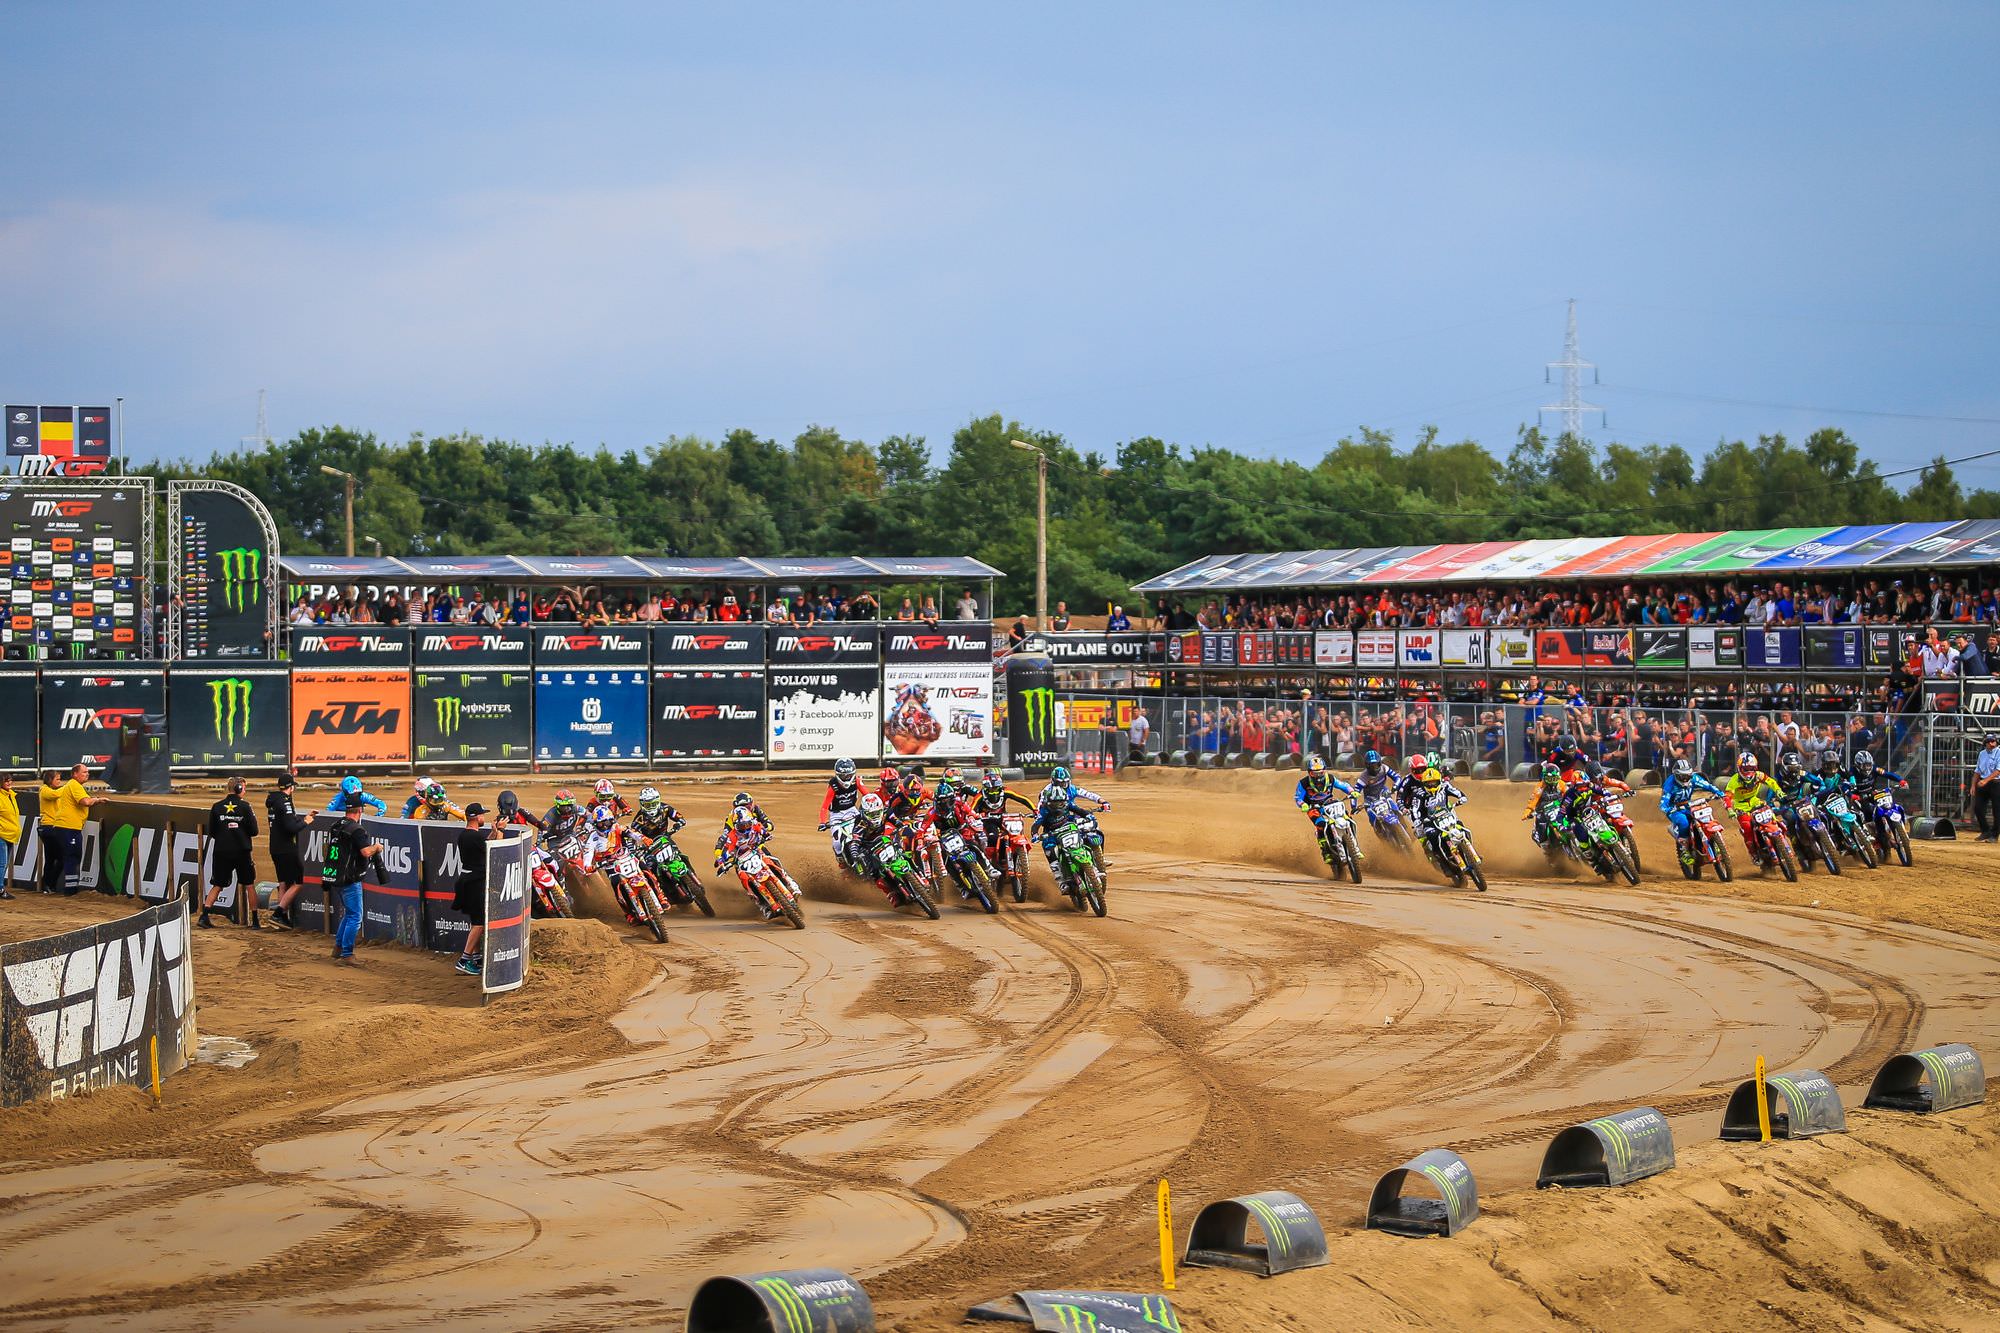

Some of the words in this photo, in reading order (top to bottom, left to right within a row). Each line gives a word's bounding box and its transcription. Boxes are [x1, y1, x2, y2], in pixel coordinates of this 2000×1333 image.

[19, 454, 111, 477] MXGP
[31, 500, 94, 518] MXGP
[1111, 642, 1143, 655] OUT
[773, 675, 820, 686] FOLLOW
[821, 675, 838, 685] US
[461, 703, 512, 713] MONSTER
[800, 710, 874, 720] Facebook/mxgp
[302, 701, 401, 735] KTM
[799, 727, 834, 736] @mxgp
[799, 743, 834, 752] @mxgp
[1755, 809, 1774, 823] 818
[620, 860, 637, 874] 61
[3, 924, 158, 1069] FLY
[51, 1049, 139, 1101] RACING
